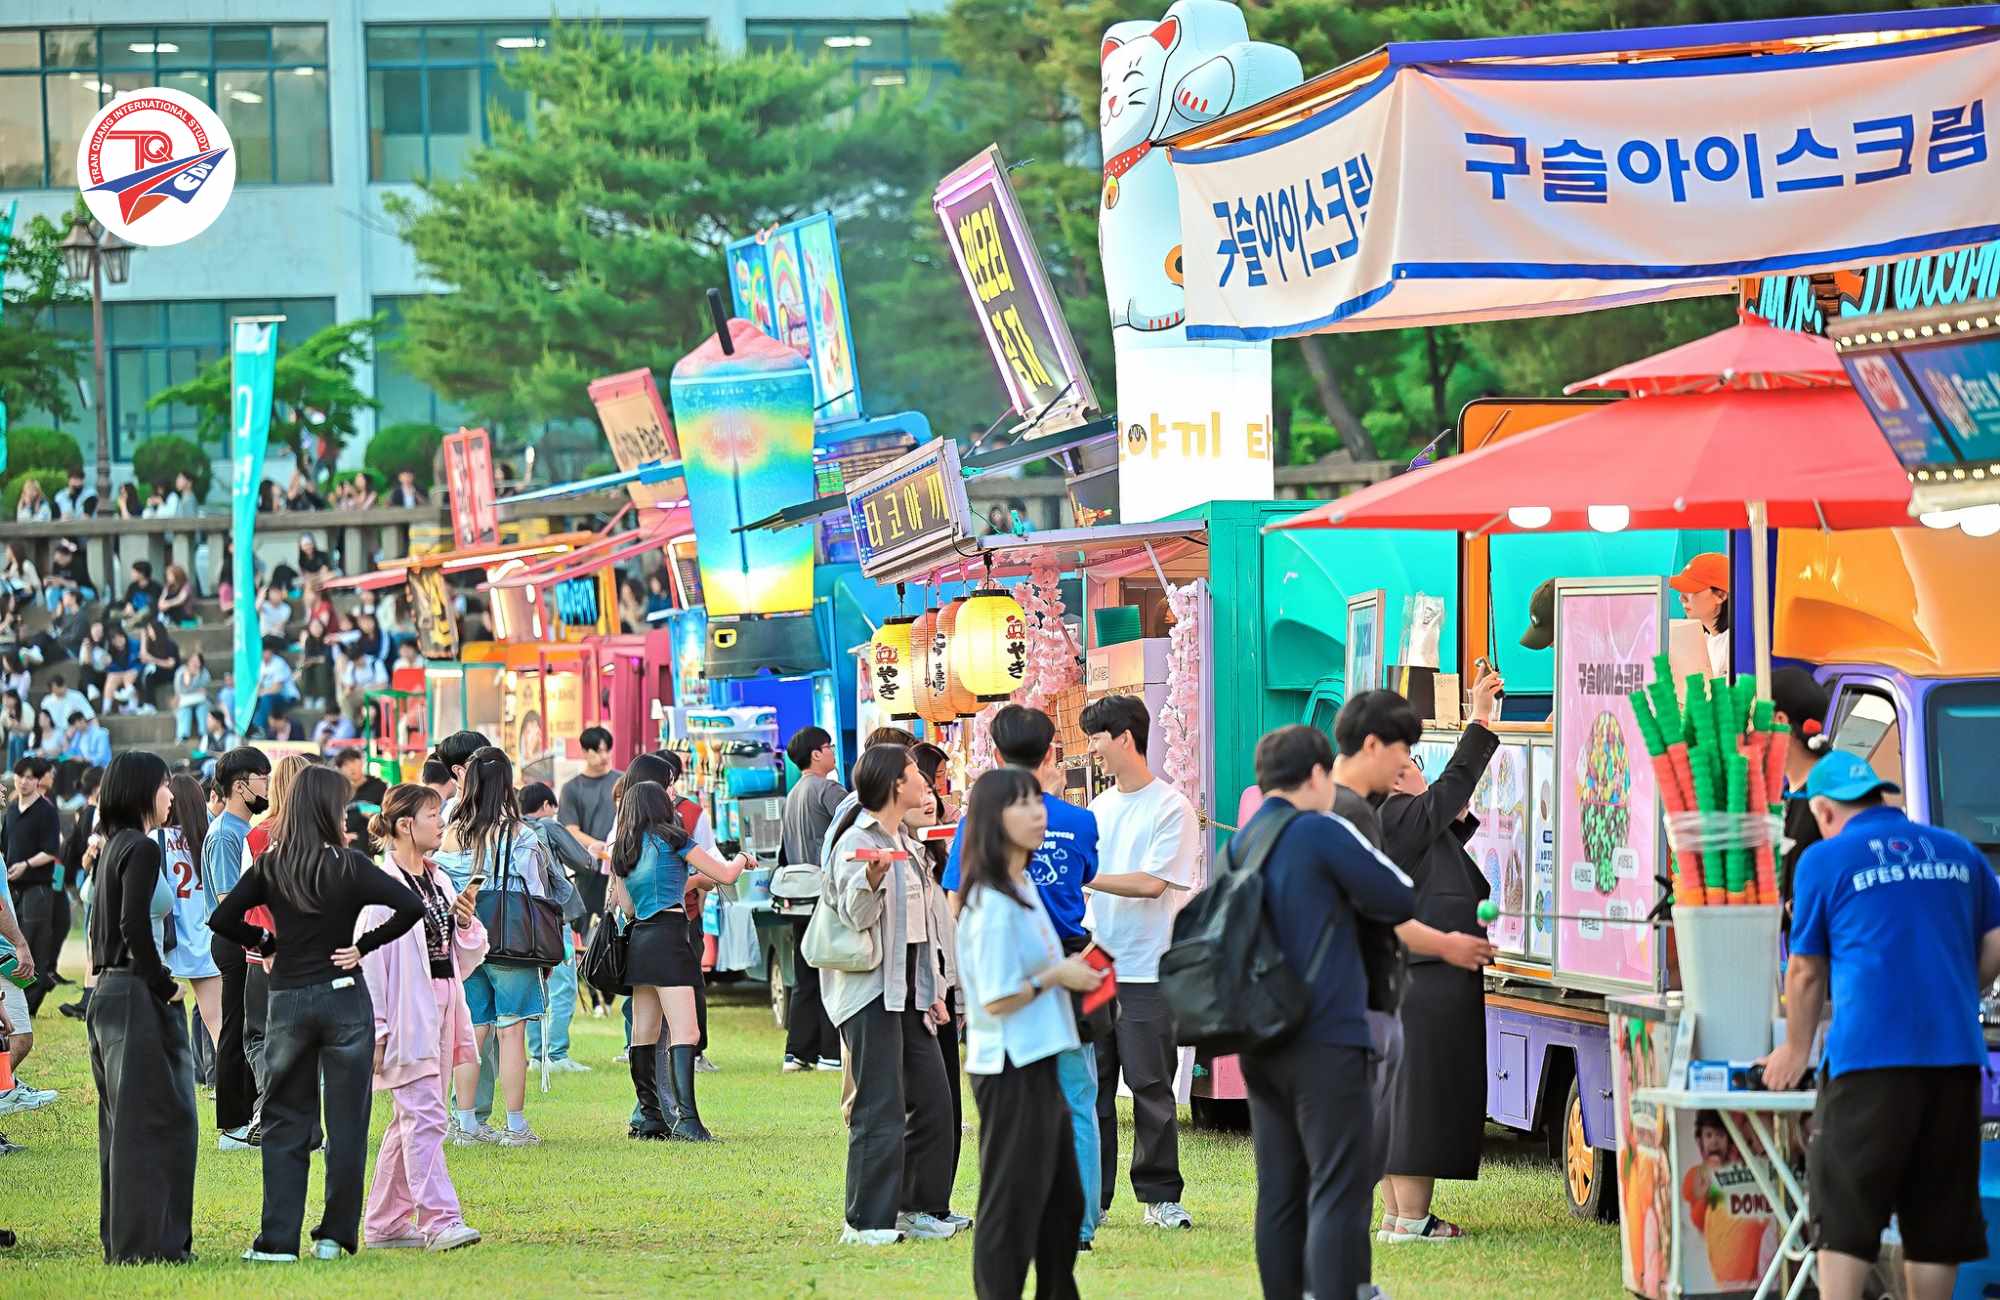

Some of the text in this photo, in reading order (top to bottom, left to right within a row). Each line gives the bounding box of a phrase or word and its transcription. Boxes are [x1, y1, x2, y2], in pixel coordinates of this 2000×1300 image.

[1464, 98, 1988, 204] 구슬아이스크림
[862, 471, 950, 548] 타코야끼
[1007, 641, 1026, 679] やき
[877, 665, 899, 700] やき
[1852, 862, 1970, 892] EFES KEBAB
